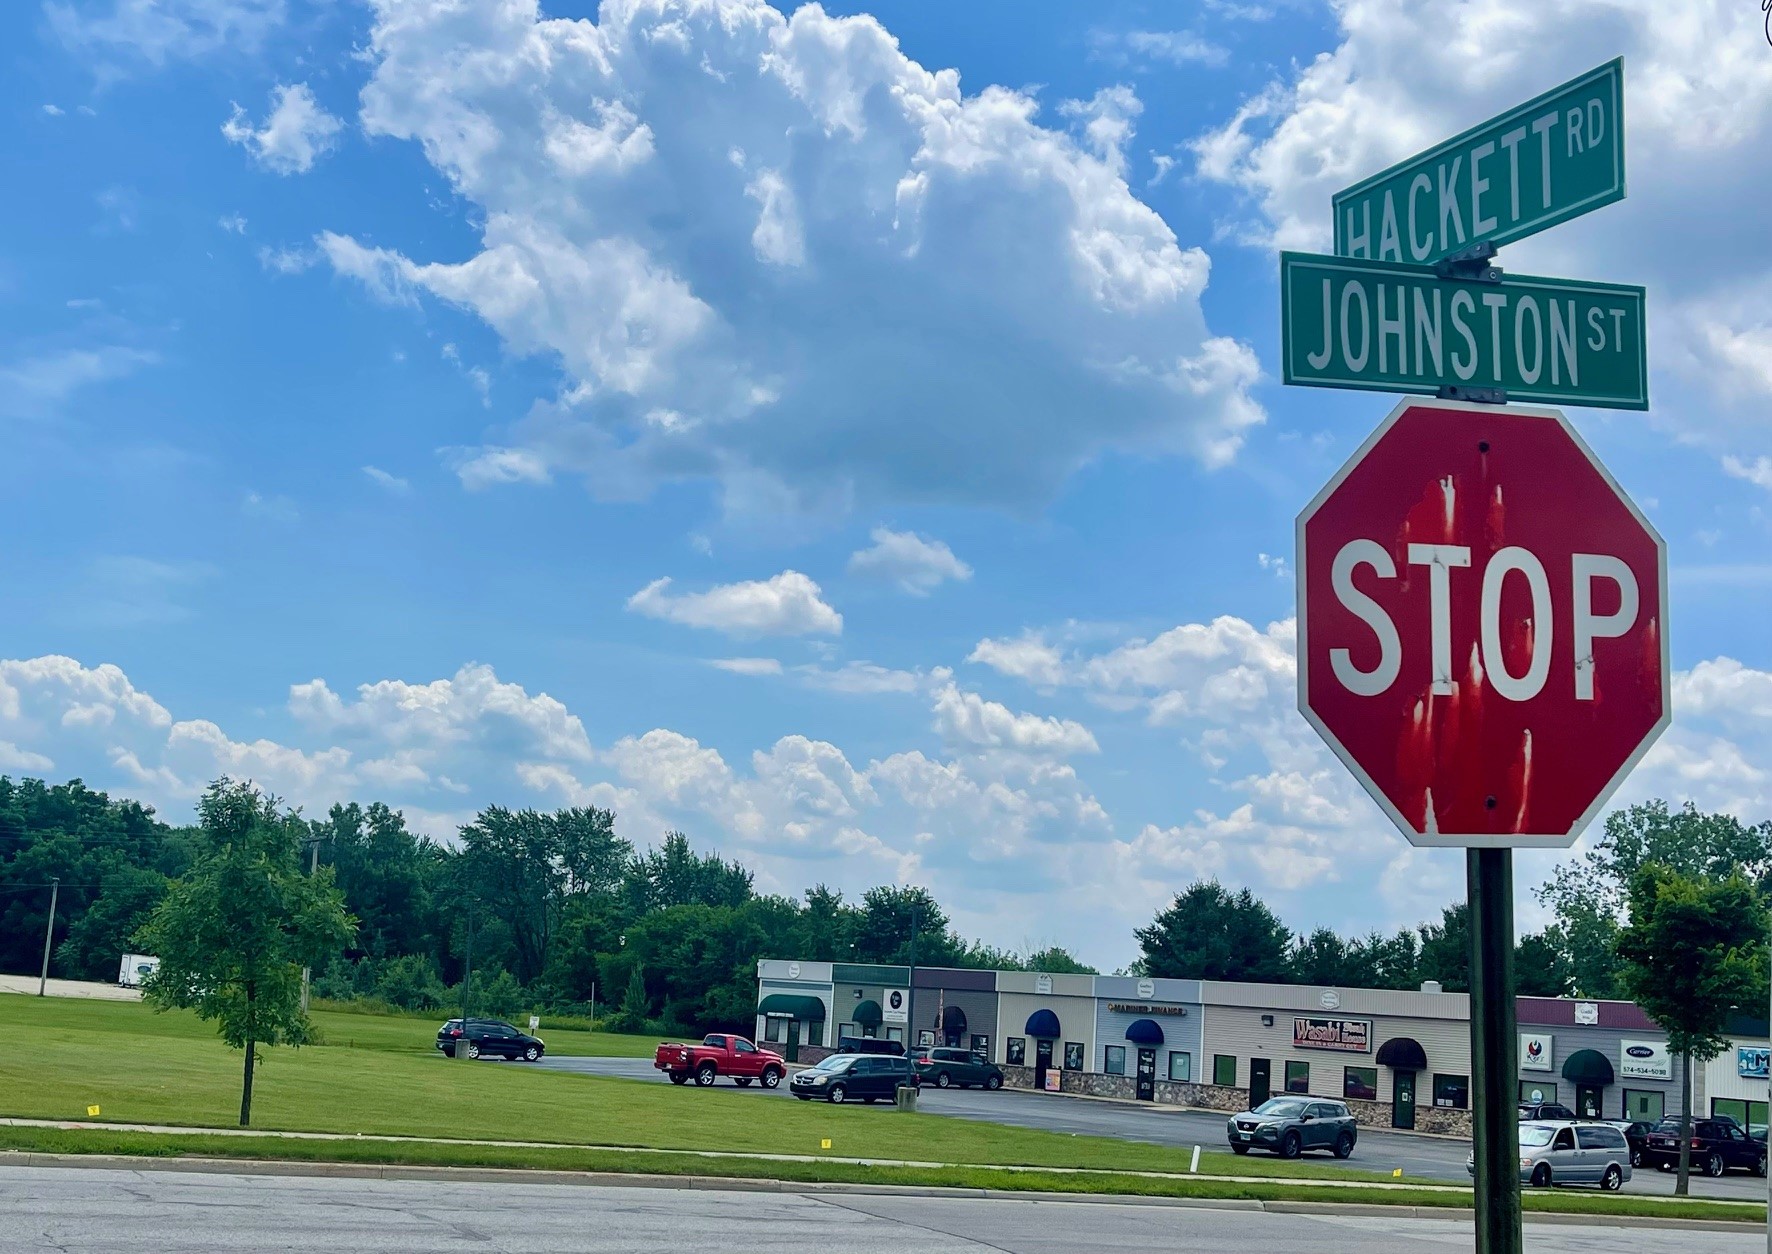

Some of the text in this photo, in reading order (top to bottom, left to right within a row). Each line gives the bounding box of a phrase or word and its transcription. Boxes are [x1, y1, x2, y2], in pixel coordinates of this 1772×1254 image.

[1347, 97, 1605, 263] HACKETT RD
[1307, 278, 1626, 386] JOHNSTON ST
[1329, 538, 1640, 702] STOP
[1295, 1019, 1340, 1041] Wasabi
